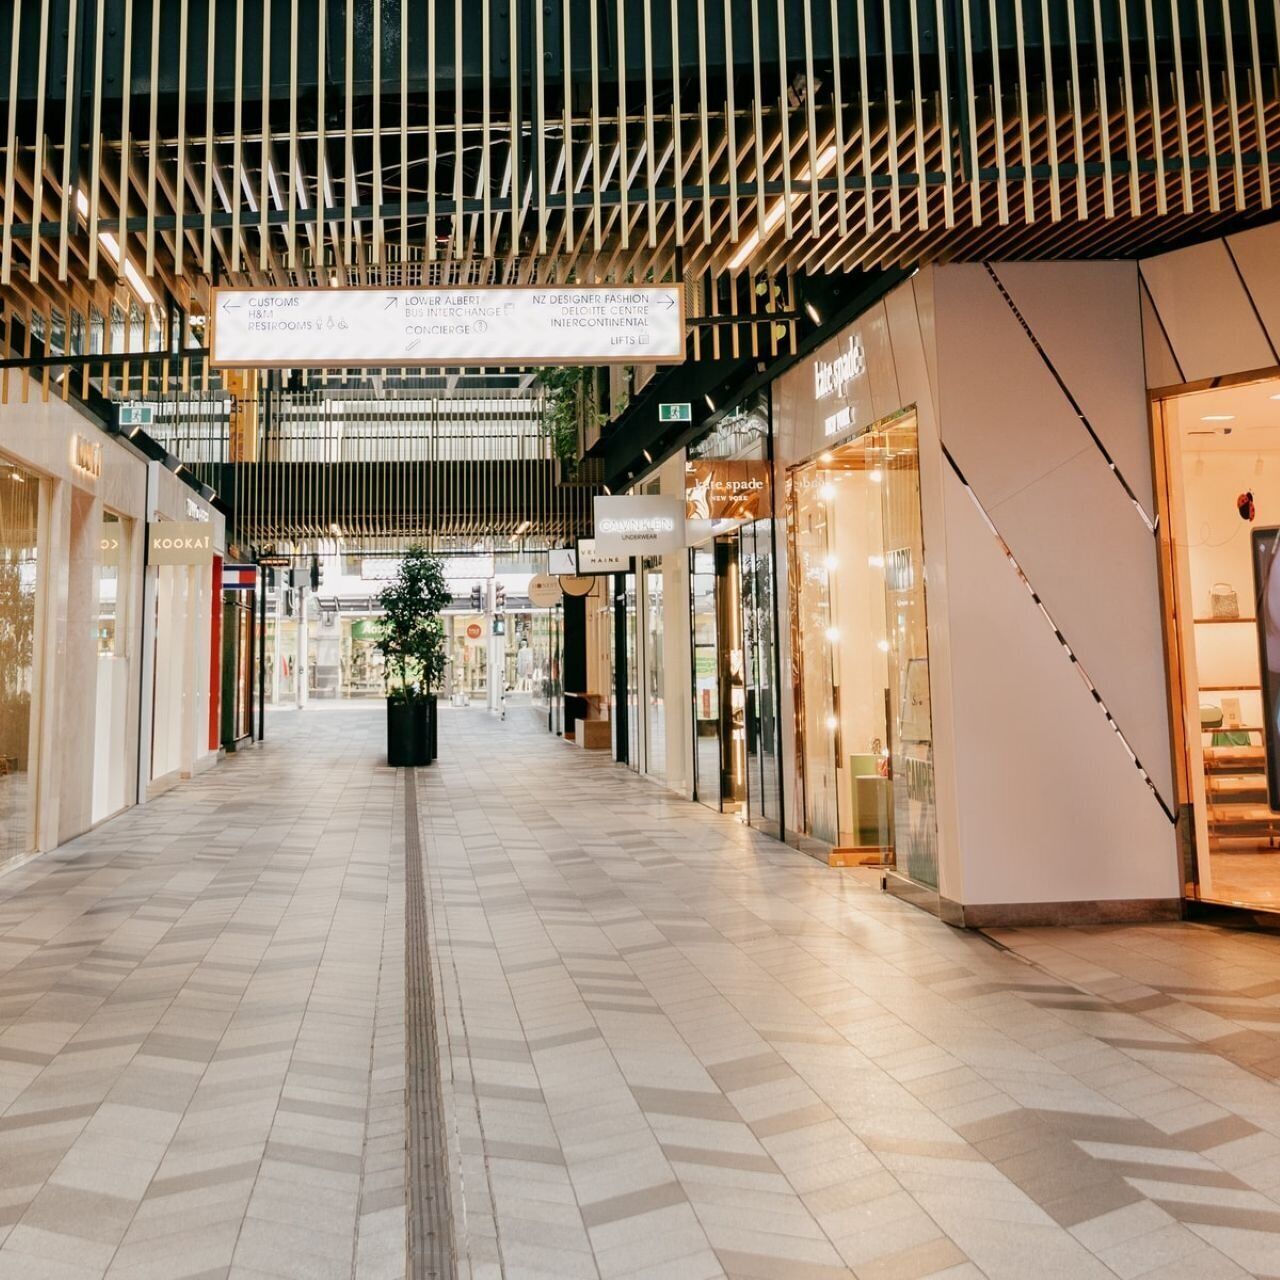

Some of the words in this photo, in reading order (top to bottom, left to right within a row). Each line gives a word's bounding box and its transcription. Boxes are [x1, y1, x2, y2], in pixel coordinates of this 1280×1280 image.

[248, 297, 300, 307] CUSTOMS
[404, 296, 441, 306] LOWER
[445, 295, 480, 306] ALBERT
[532, 294, 546, 305] NZ
[549, 294, 601, 304] DESIGNER
[604, 293, 649, 304] FASHION
[404, 308, 424, 318] BUS
[427, 307, 500, 317] INTERCHANGE
[561, 306, 606, 316] DELOITTE
[610, 305, 649, 316] CENTRE
[248, 320, 312, 331] RESTROOMS
[550, 317, 649, 328] INTERCONTINENTAL
[404, 324, 470, 335] CONCIERGE
[610, 336, 636, 346] LIFTS
[695, 478, 723, 490] kate
[725, 478, 763, 493] spade
[153, 536, 210, 549] KOOKAÏ
[621, 533, 657, 541] UNDERWEAR
